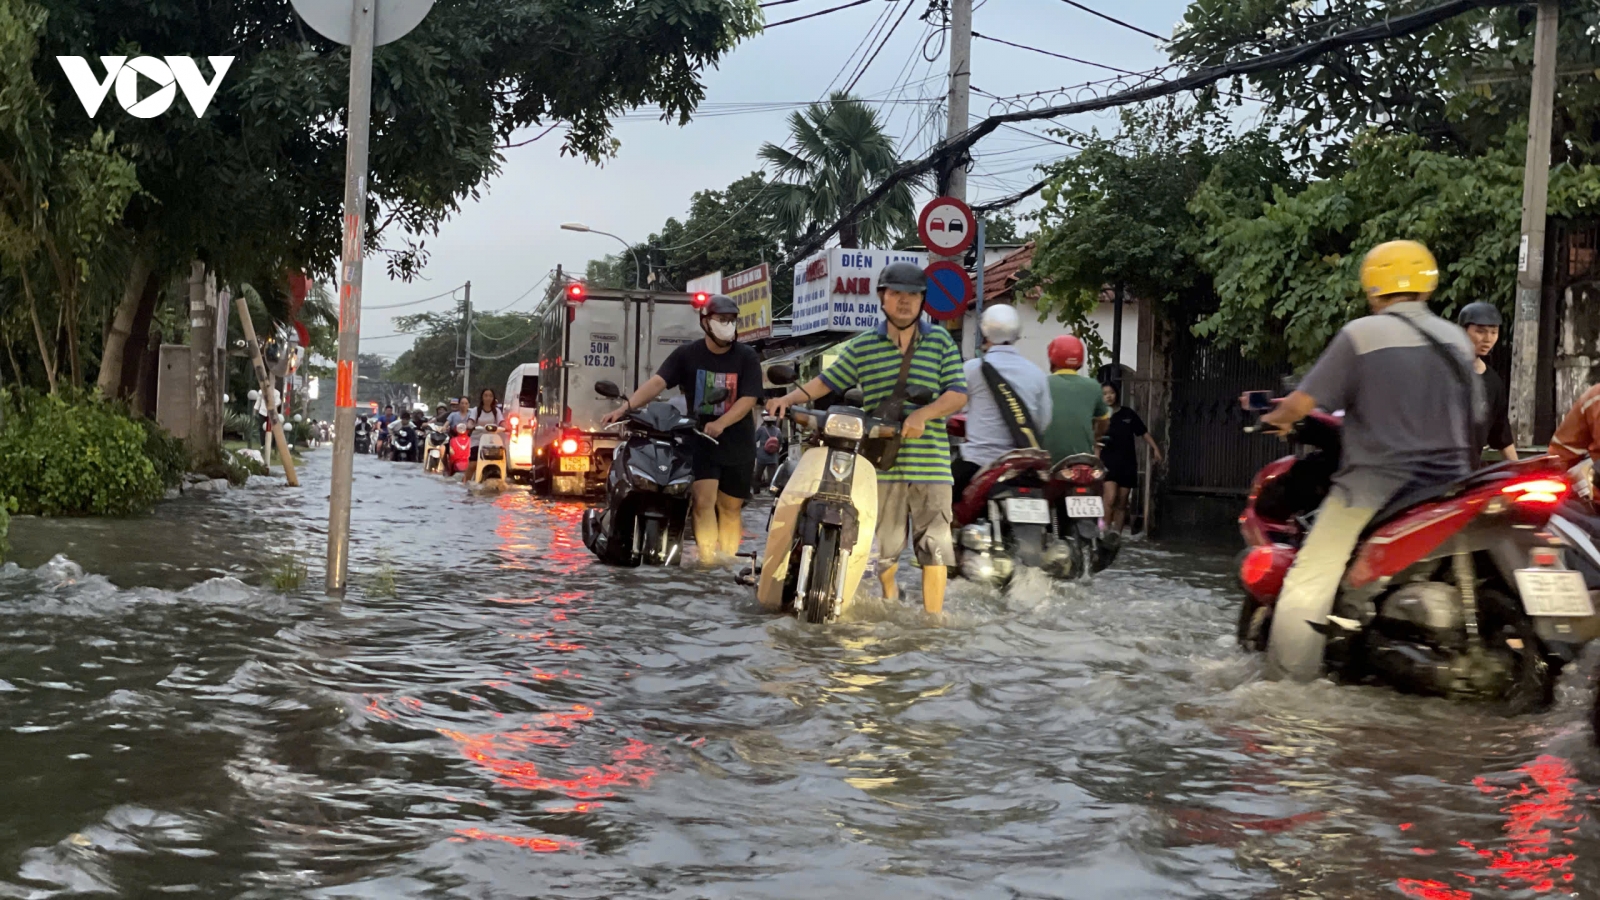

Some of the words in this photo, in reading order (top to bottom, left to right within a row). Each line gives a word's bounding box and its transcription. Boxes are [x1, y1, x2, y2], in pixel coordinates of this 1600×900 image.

[841, 252, 873, 270] ĐIỆN
[833, 276, 871, 295] ANH
[834, 302, 854, 313] MUA
[590, 342, 609, 354] 50H
[584, 355, 615, 367] 126.20
